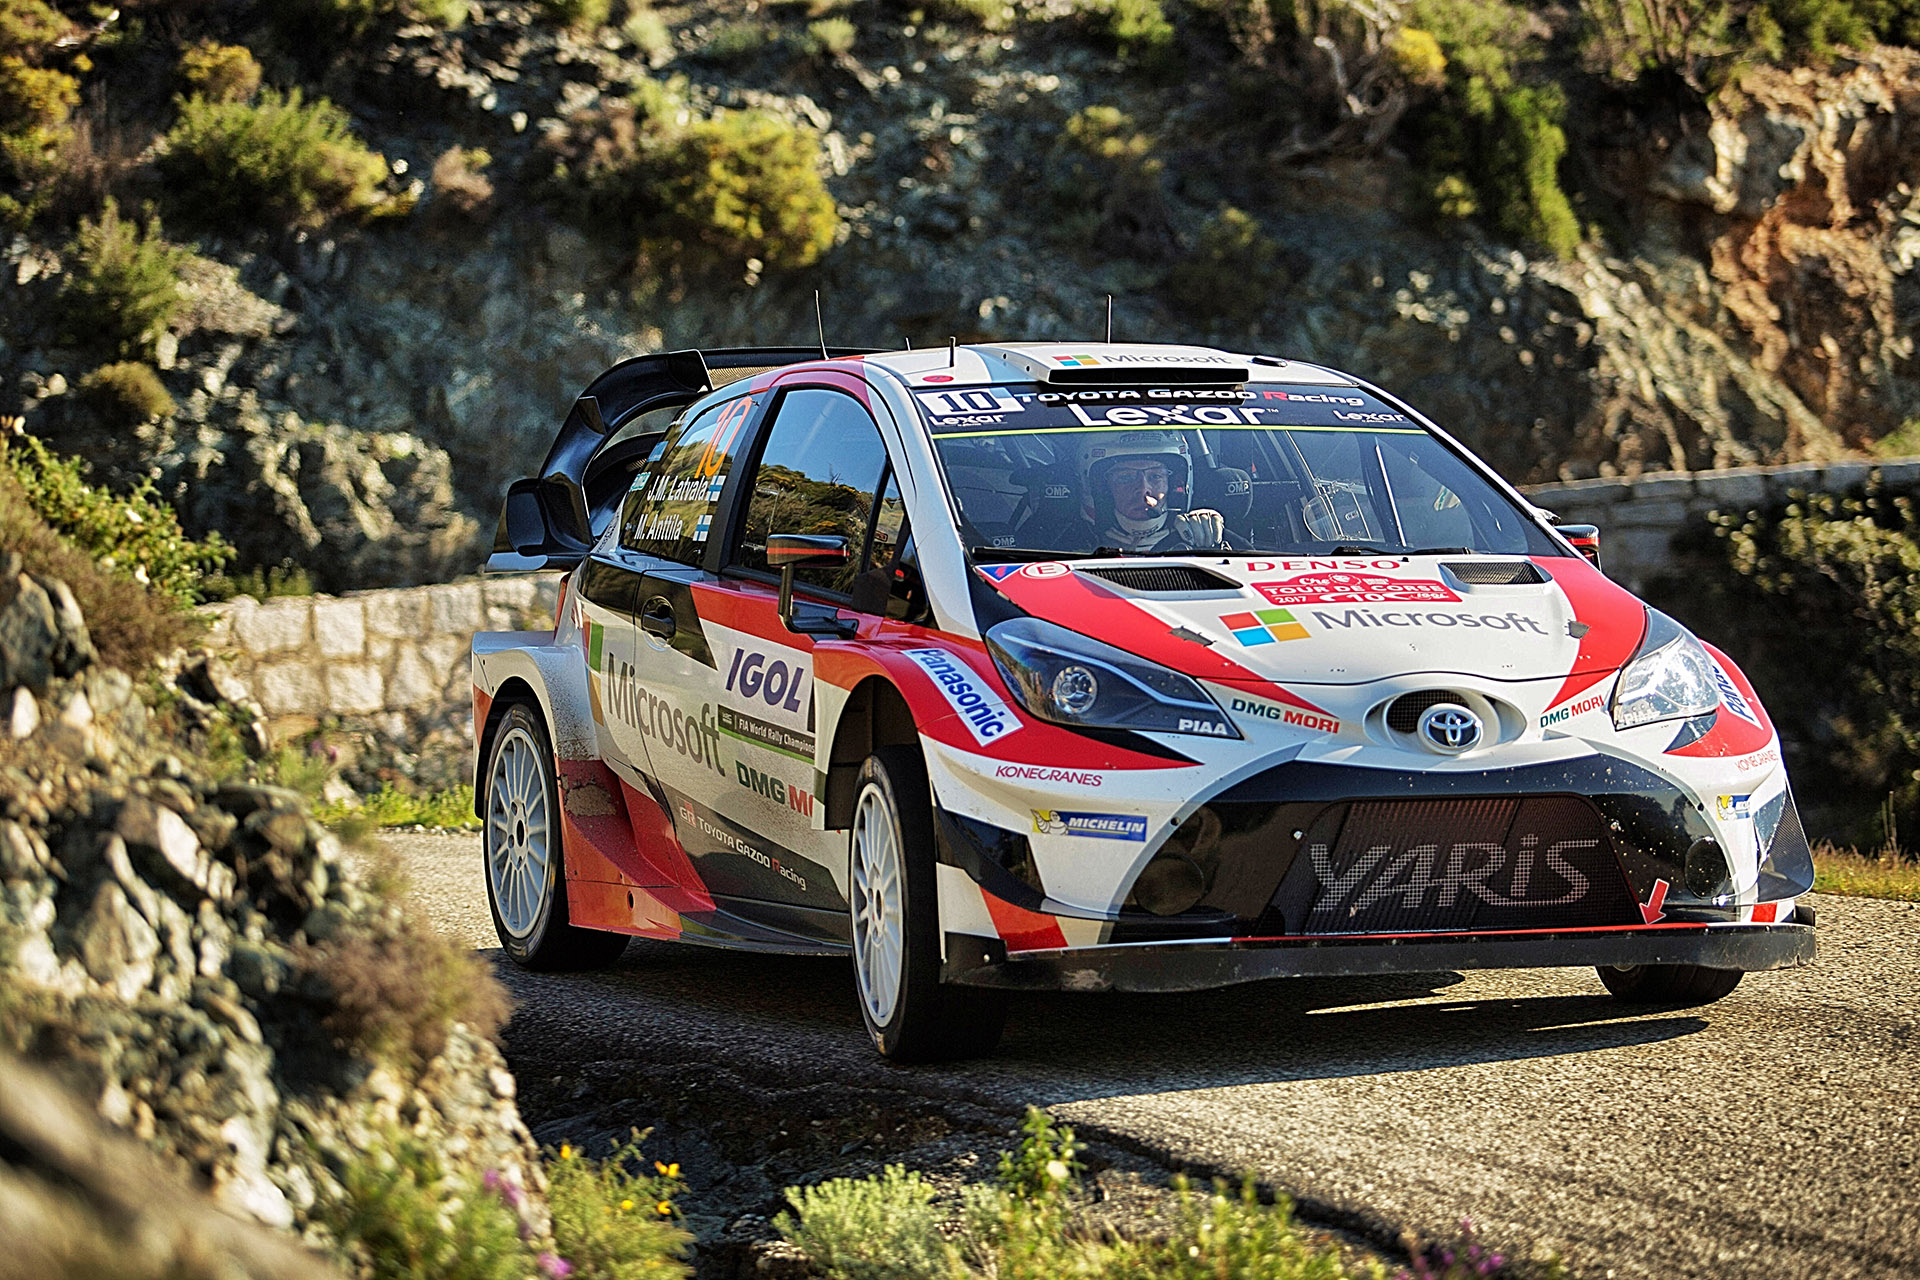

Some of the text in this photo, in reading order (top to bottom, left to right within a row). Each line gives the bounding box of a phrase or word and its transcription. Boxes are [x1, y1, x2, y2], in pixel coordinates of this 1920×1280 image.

[1102, 354, 1231, 364] Microsoft
[938, 391, 1002, 412] 10
[1014, 388, 1365, 407] TOYOTA GAZOO Racing
[928, 414, 1006, 427] Lexar
[1067, 403, 1266, 427] Lexar
[1333, 410, 1405, 422] Lexar
[694, 396, 753, 479] 10
[668, 475, 709, 501] Latvala
[1045, 486, 1070, 497] OMP
[1227, 481, 1250, 495] OMP
[634, 513, 648, 540] M.
[646, 513, 684, 541] Anttila
[1246, 560, 1400, 572] DENSO
[1264, 586, 1330, 595] TOUR
[1333, 585, 1366, 593] DE
[1299, 577, 1331, 586] Che
[1275, 596, 1307, 604] 2017
[1311, 608, 1548, 636] Microsoft
[726, 648, 804, 713] IGOL
[911, 648, 1005, 738] Panasonic
[607, 652, 726, 777] Microsoft
[1231, 697, 1341, 734] DMG MORI
[1540, 694, 1604, 728] DMG MORI
[739, 718, 749, 732] FIA
[749, 721, 767, 738] World
[767, 728, 784, 745] Rally
[1178, 718, 1228, 735] PIAA
[735, 760, 786, 805] DMG
[995, 765, 1103, 787] KONECRANES
[1067, 815, 1145, 833] MICHELIN
[696, 815, 735, 849] TOYOTA
[735, 838, 771, 869] GAZOO
[771, 857, 807, 891] Racing
